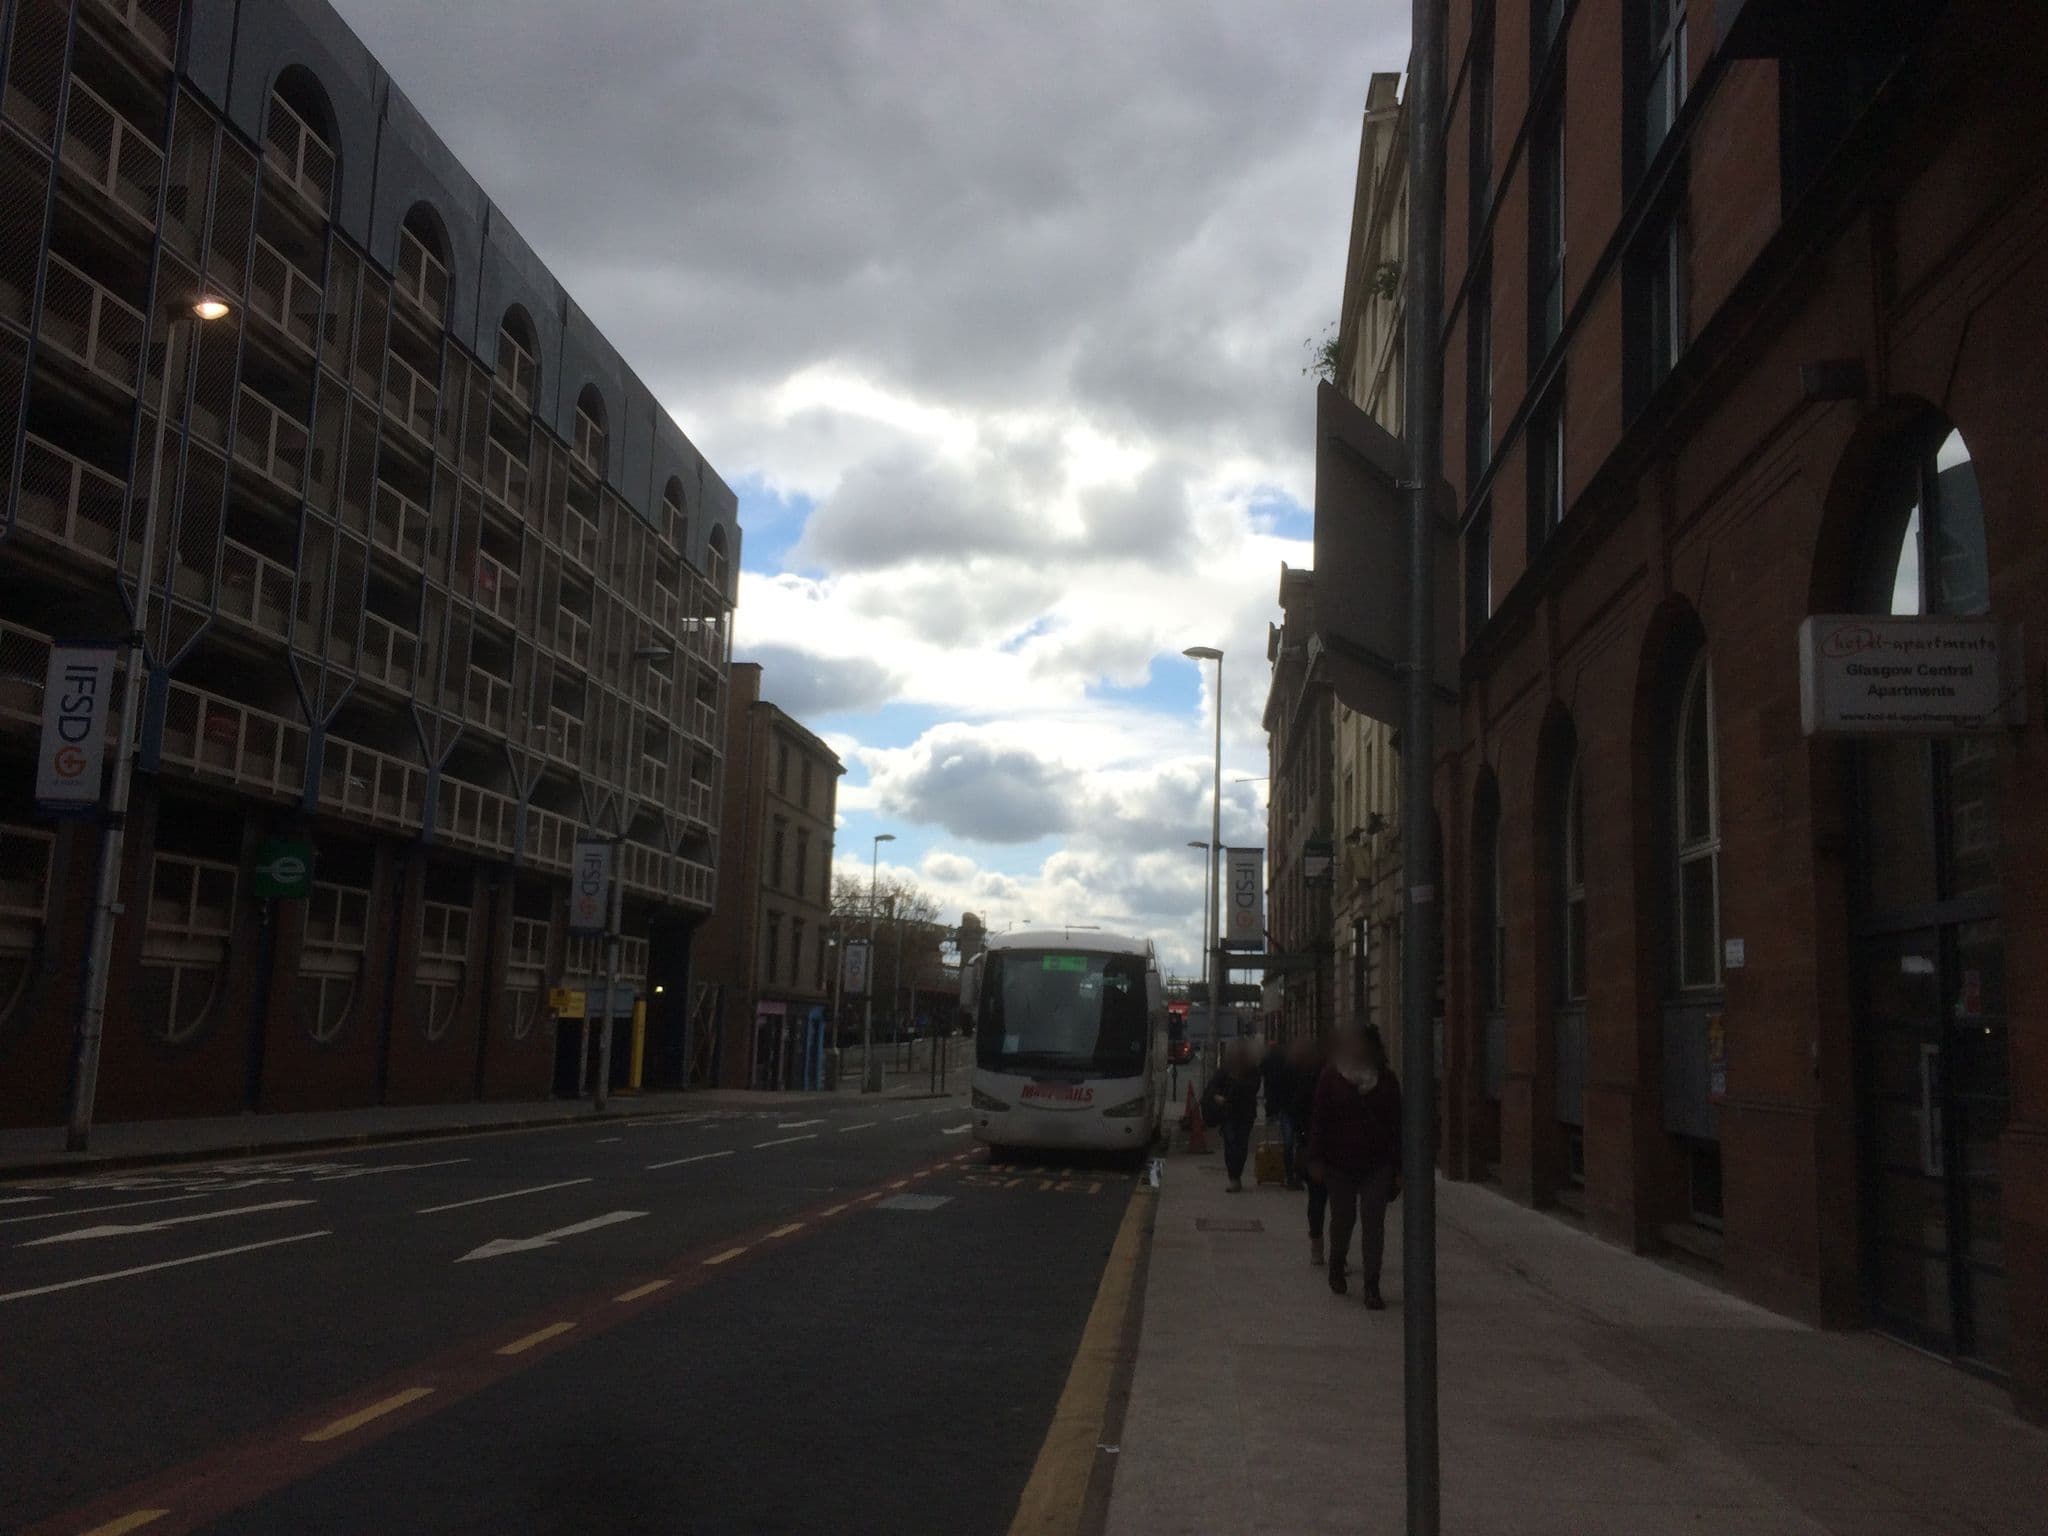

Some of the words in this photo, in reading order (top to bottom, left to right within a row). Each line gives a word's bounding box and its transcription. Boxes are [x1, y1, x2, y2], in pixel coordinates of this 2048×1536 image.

[1846, 663, 1912, 679] Glasgow
[1917, 662, 1974, 677] Central
[1868, 684, 1955, 699] Apartments
[58, 665, 98, 743] IFSD
[581, 852, 602, 896] IFSD
[1236, 863, 1255, 908] IFSD
